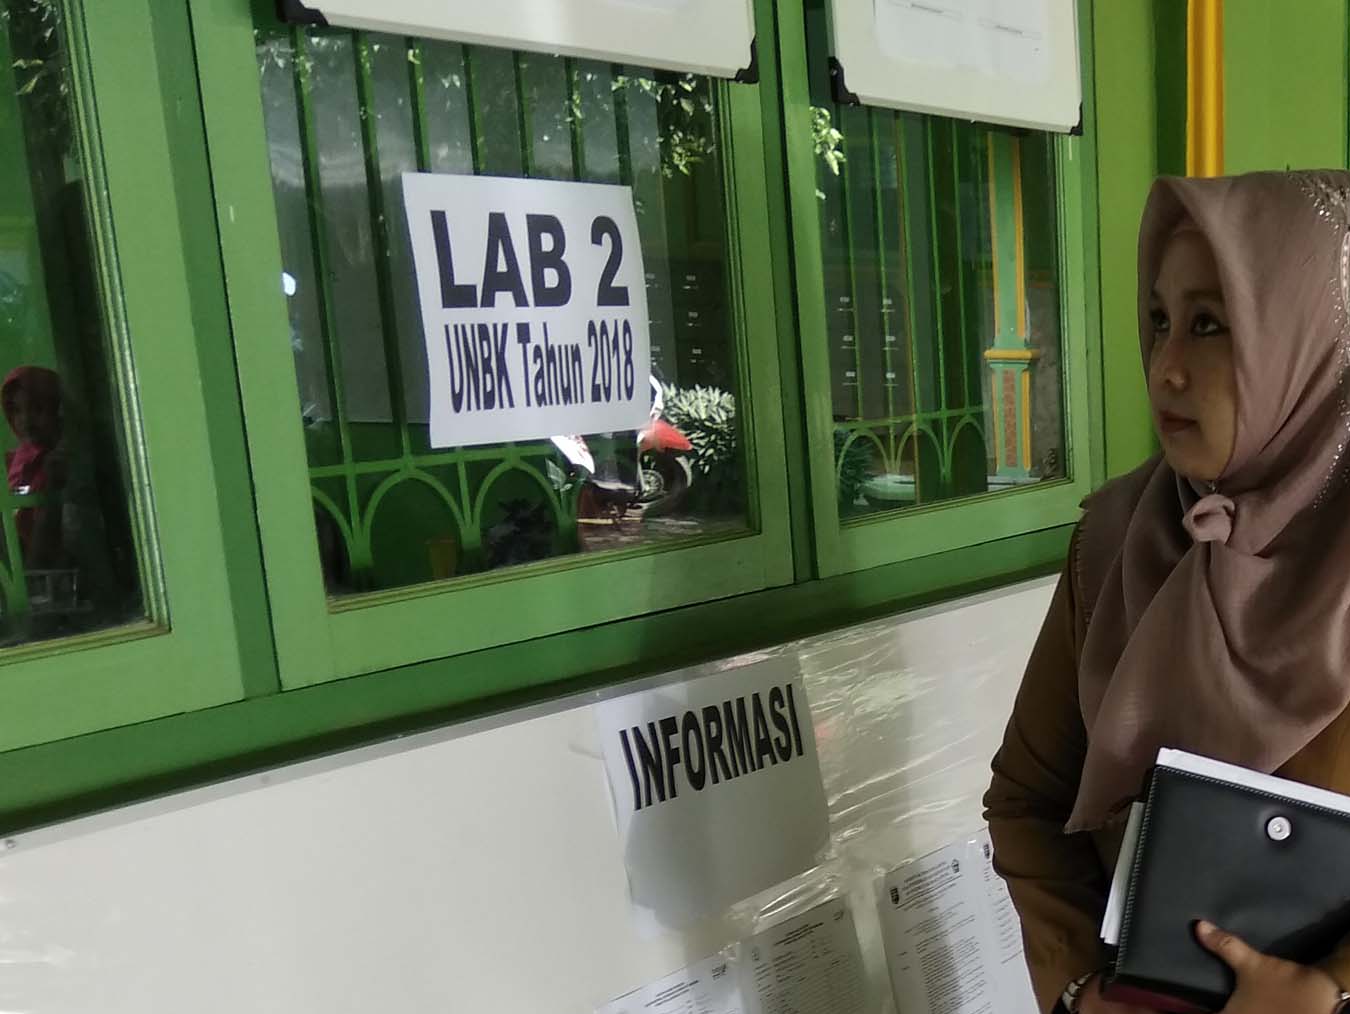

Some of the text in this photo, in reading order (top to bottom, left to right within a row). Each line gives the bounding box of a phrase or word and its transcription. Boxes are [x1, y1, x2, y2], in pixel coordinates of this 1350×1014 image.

[430, 209, 630, 309] LAB 2
[444, 318, 635, 414] UNBK Tahun 2018
[618, 683, 804, 811] INFORMASI
